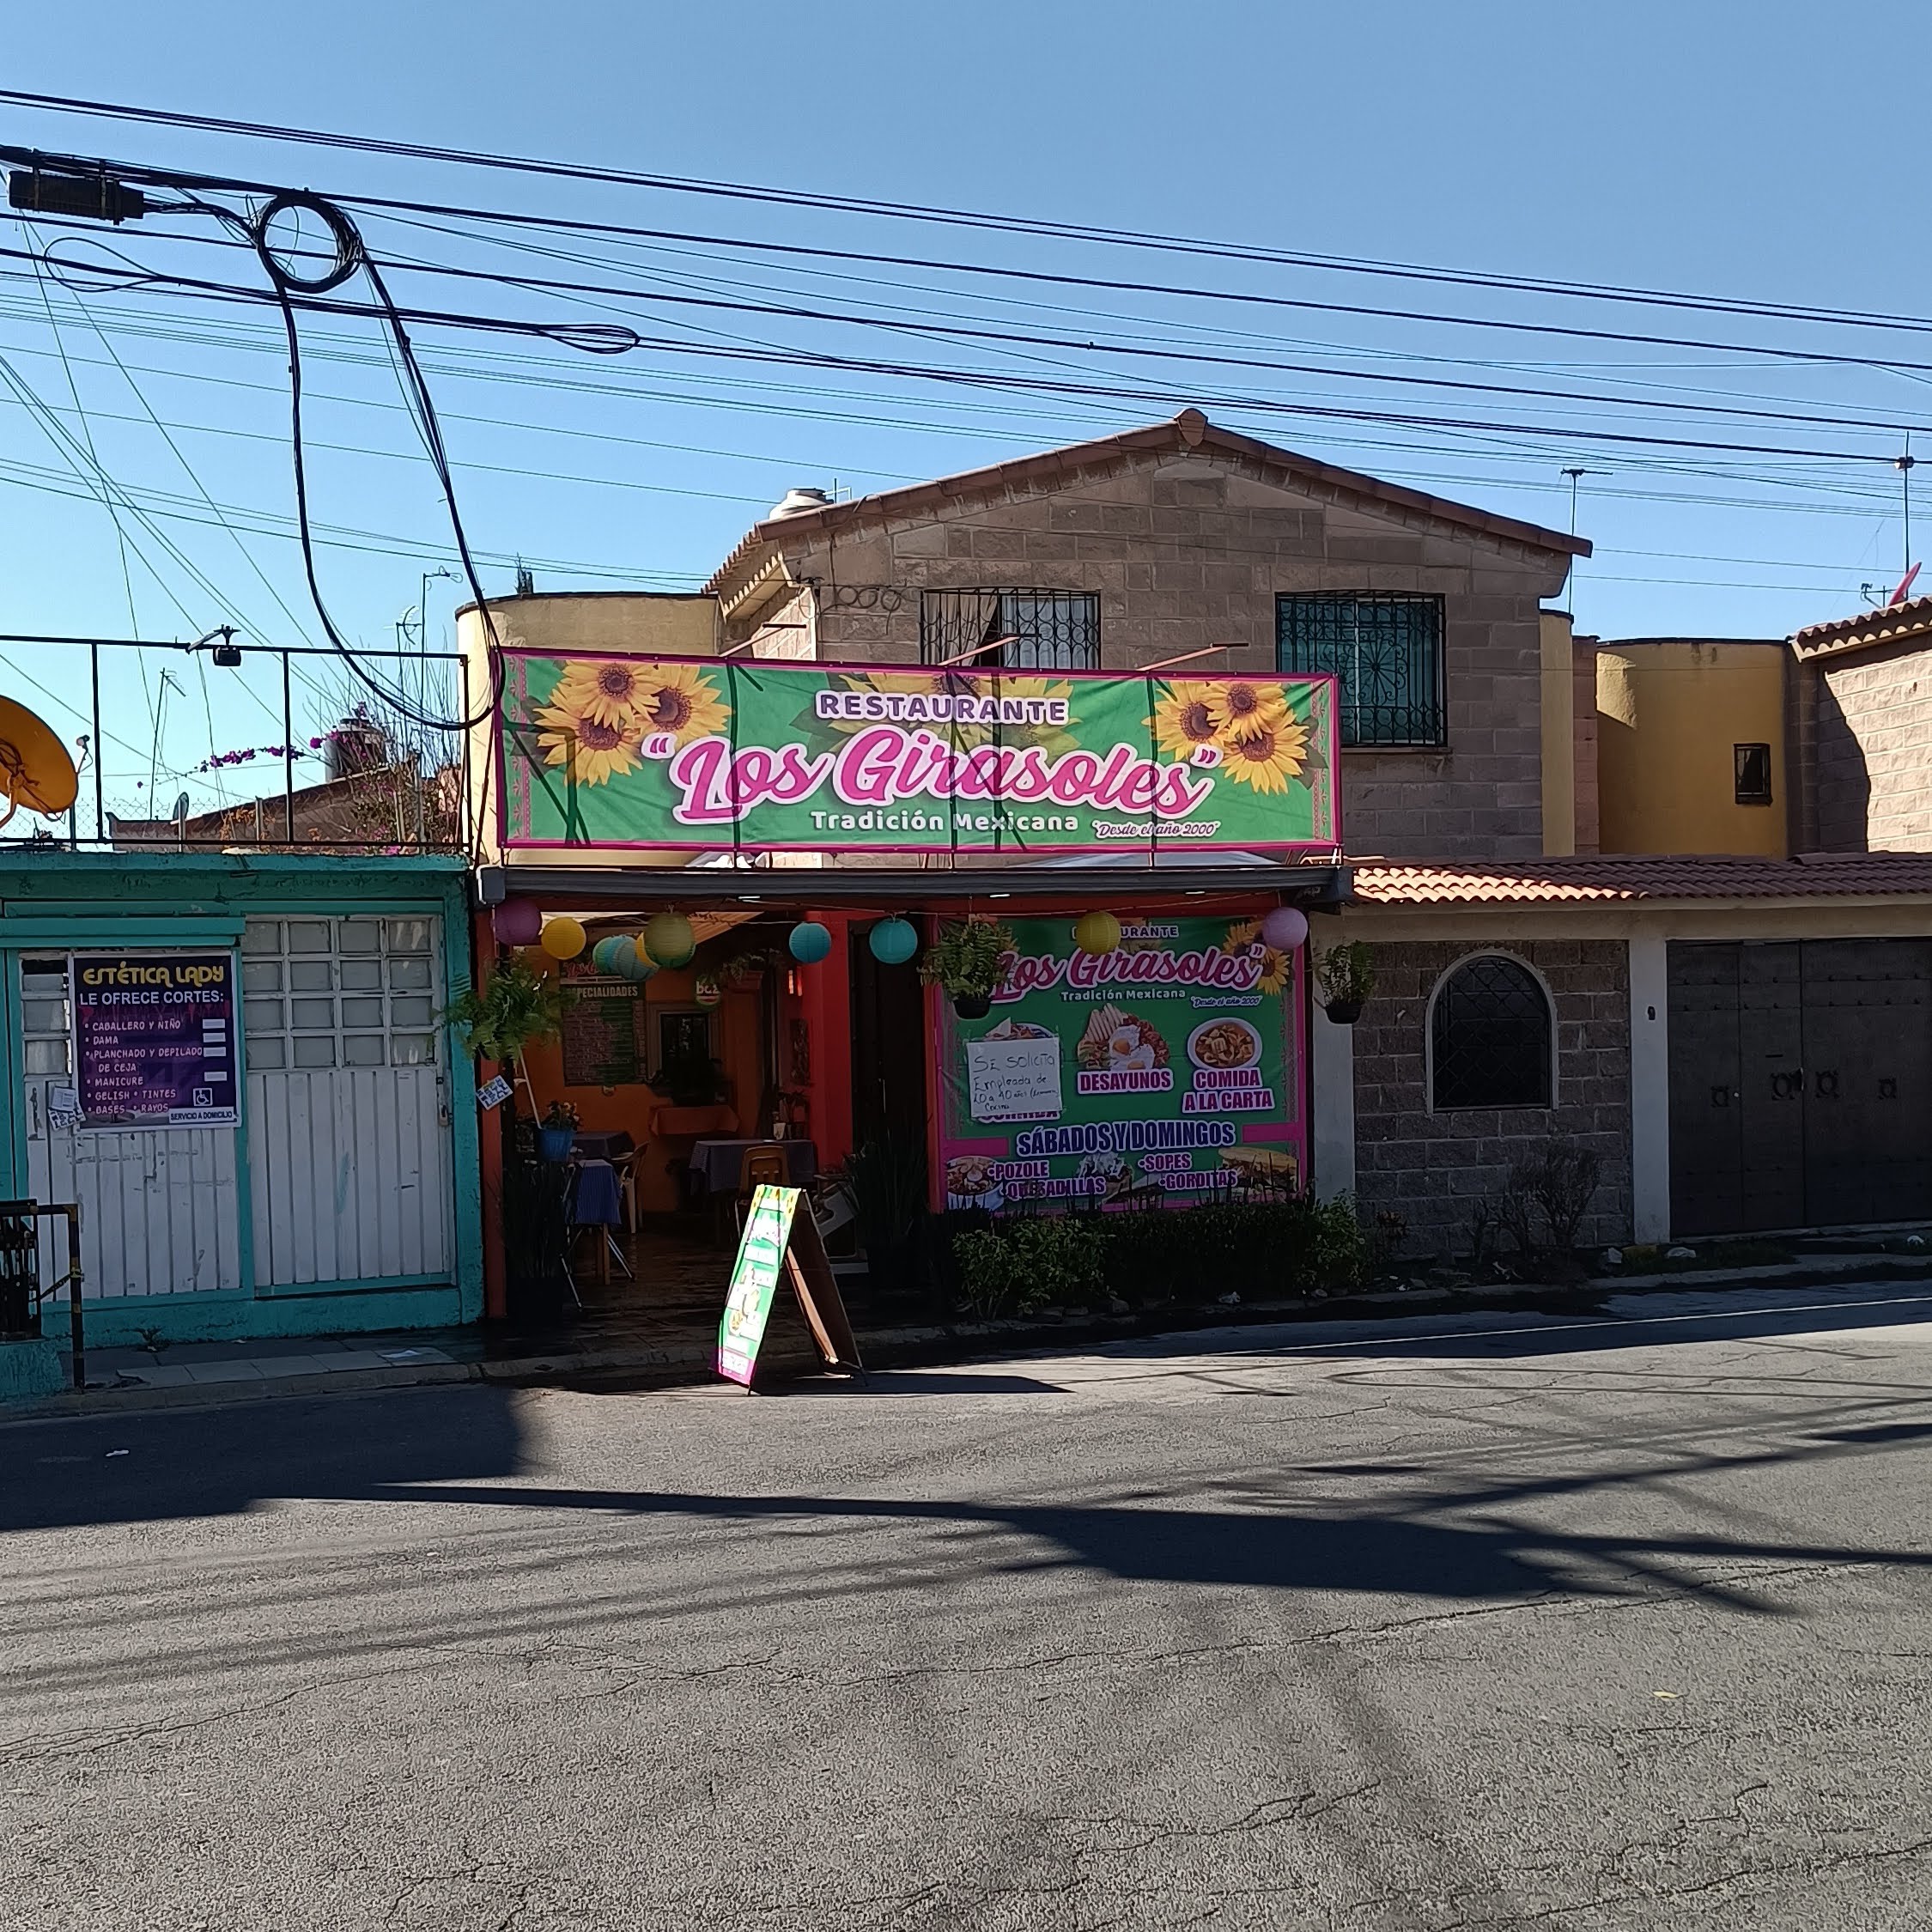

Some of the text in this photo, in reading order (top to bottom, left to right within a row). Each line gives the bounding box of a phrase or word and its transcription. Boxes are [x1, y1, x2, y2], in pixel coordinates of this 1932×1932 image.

[820, 694, 1066, 721] RESTAURANTE
[810, 809, 1078, 830] Tradición Mexicana
[1140, 822, 1154, 835] el
[1155, 823, 1182, 835] año
[82, 960, 225, 988] ESTÉTICA LADY
[80, 989, 225, 1005] LE OFRECE CORTES:
[565, 987, 638, 999] PECIALIDADES
[1061, 987, 1186, 1000] Tradición Mexicana
[1217, 996, 1224, 1005] el
[92, 1018, 181, 1031] CABALLERO Y NIÑO
[93, 1036, 119, 1045] DAMA
[94, 1047, 203, 1059] PLANCHADO Y DEPILADO
[98, 1063, 137, 1072] DE CEJA
[94, 1076, 144, 1087] MANICURE
[1080, 1071, 1171, 1091] DESAYUNOS
[1195, 1069, 1261, 1089] COMIDA
[94, 1089, 177, 1101] GELISH TINTES
[1184, 1091, 1273, 1111] A LA CARTA
[141, 1103, 169, 1114] RAYOS
[170, 1112, 197, 1121] SERVICIO
[203, 1110, 233, 1120] DOMICILIO
[1018, 1123, 1235, 1156] SÁBADOS Y DOMINGOS
[1145, 1154, 1191, 1170] SOPES
[995, 1162, 1048, 1179] POZOLE
[1165, 1171, 1238, 1189] GORDITAS
